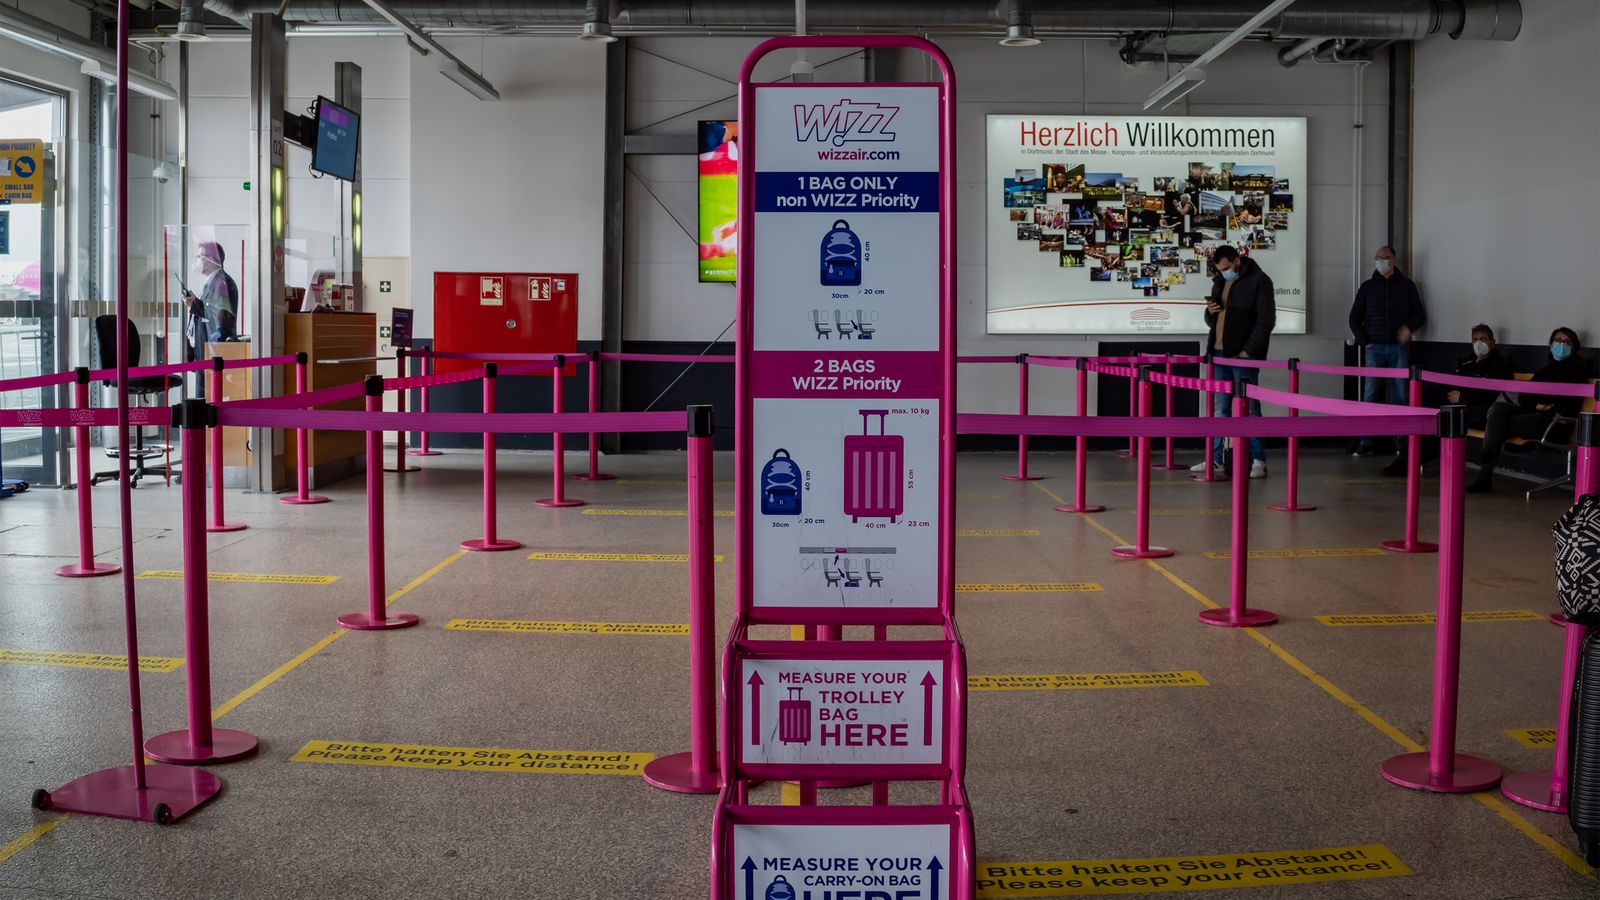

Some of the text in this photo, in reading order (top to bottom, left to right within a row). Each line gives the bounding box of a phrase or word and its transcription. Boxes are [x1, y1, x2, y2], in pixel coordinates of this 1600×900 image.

[1021, 122, 1274, 148] Herzlich Willkommen
[818, 149, 900, 161] wizzair.com
[798, 177, 898, 190] 1 BAG ONLY
[777, 194, 920, 209] non WIZZ Priority
[865, 241, 870, 262] 40 cm
[814, 360, 876, 373] 2 BAGS
[792, 377, 902, 393] WIZZ Priority
[921, 408, 930, 416] kg
[805, 470, 811, 492] 40 cm
[908, 469, 914, 489] 55 cm
[779, 672, 907, 684] MEASURE YOUR
[819, 691, 905, 704] TROLLEY
[820, 708, 859, 721] BAG
[820, 724, 908, 746] HERE
[308, 751, 639, 770] Please keep your distance!
[326, 744, 631, 762] Bitte halten Sie Abstand!
[763, 857, 922, 871] MEASURE YOUR
[987, 850, 1368, 877] Bitte halten Sie Abstand!
[804, 875, 921, 886] CARRY-ON BAG
[977, 860, 1392, 891] Please keep your distance!
